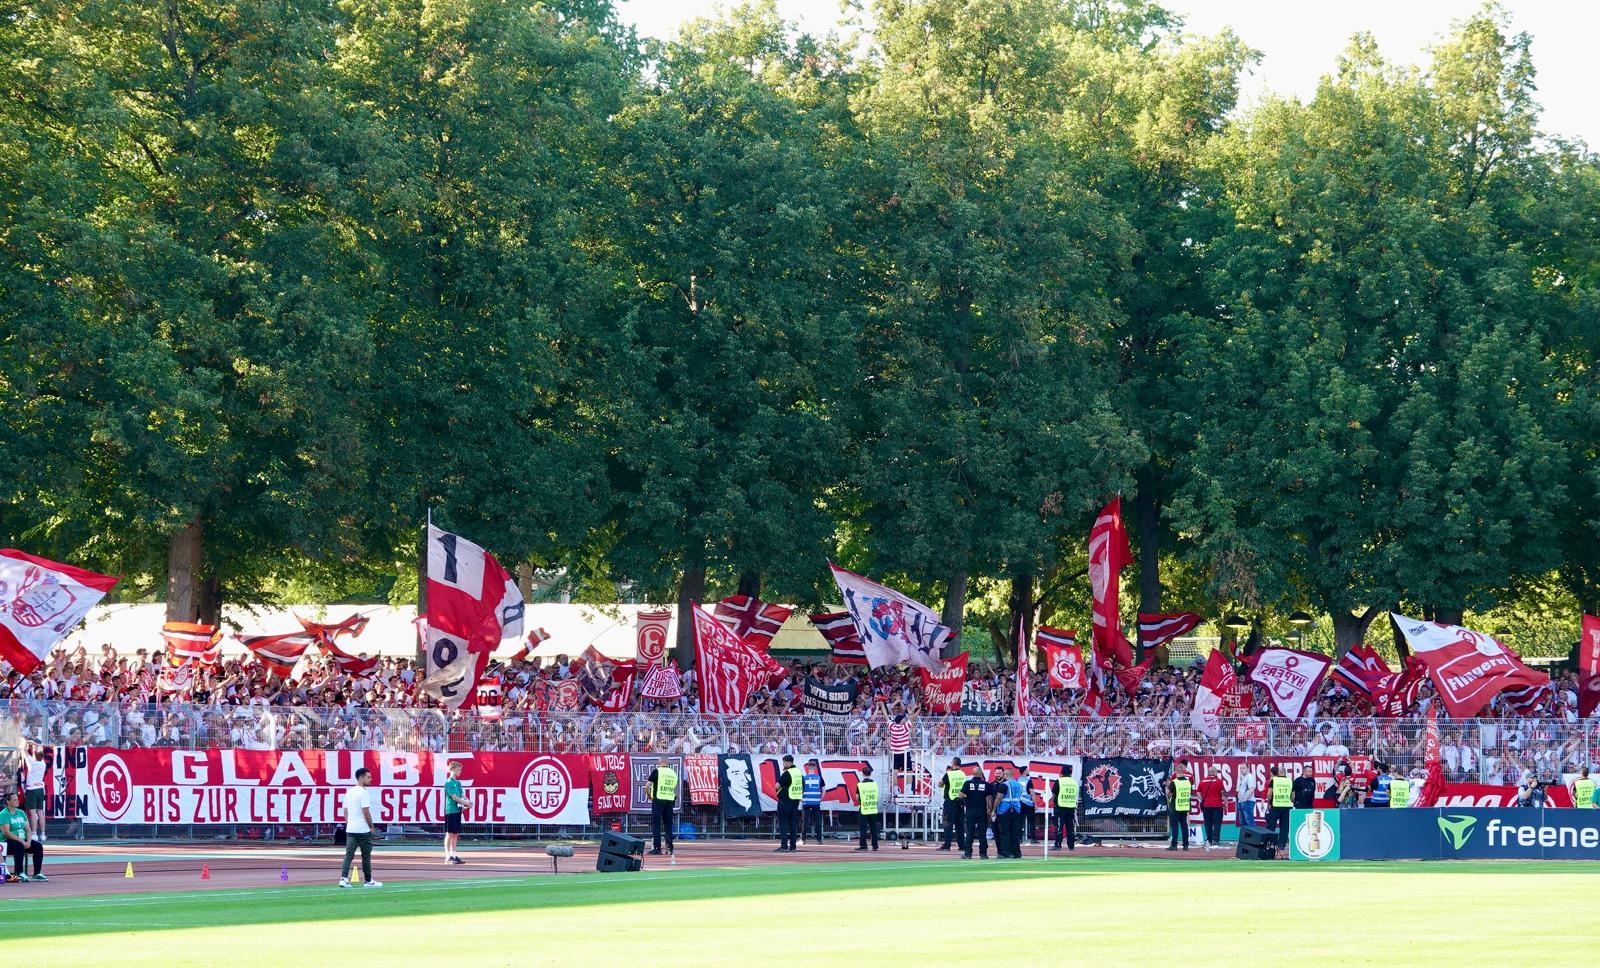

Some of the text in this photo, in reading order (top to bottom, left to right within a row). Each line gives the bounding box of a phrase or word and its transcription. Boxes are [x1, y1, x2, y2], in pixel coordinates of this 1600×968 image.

[1446, 658, 1508, 691] Flingern
[44, 747, 87, 768] SIND
[171, 750, 475, 786] GLAUBE
[594, 754, 625, 771] ULTRAS
[45, 794, 88, 817] UNEN
[110, 790, 121, 804] 95
[143, 788, 181, 822] BIS
[193, 788, 239, 822] ZUR
[250, 788, 347, 822] LETZTE
[1085, 806, 1114, 816] ultras
[1114, 806, 1141, 816] gegen
[1486, 818, 1599, 848] freene
